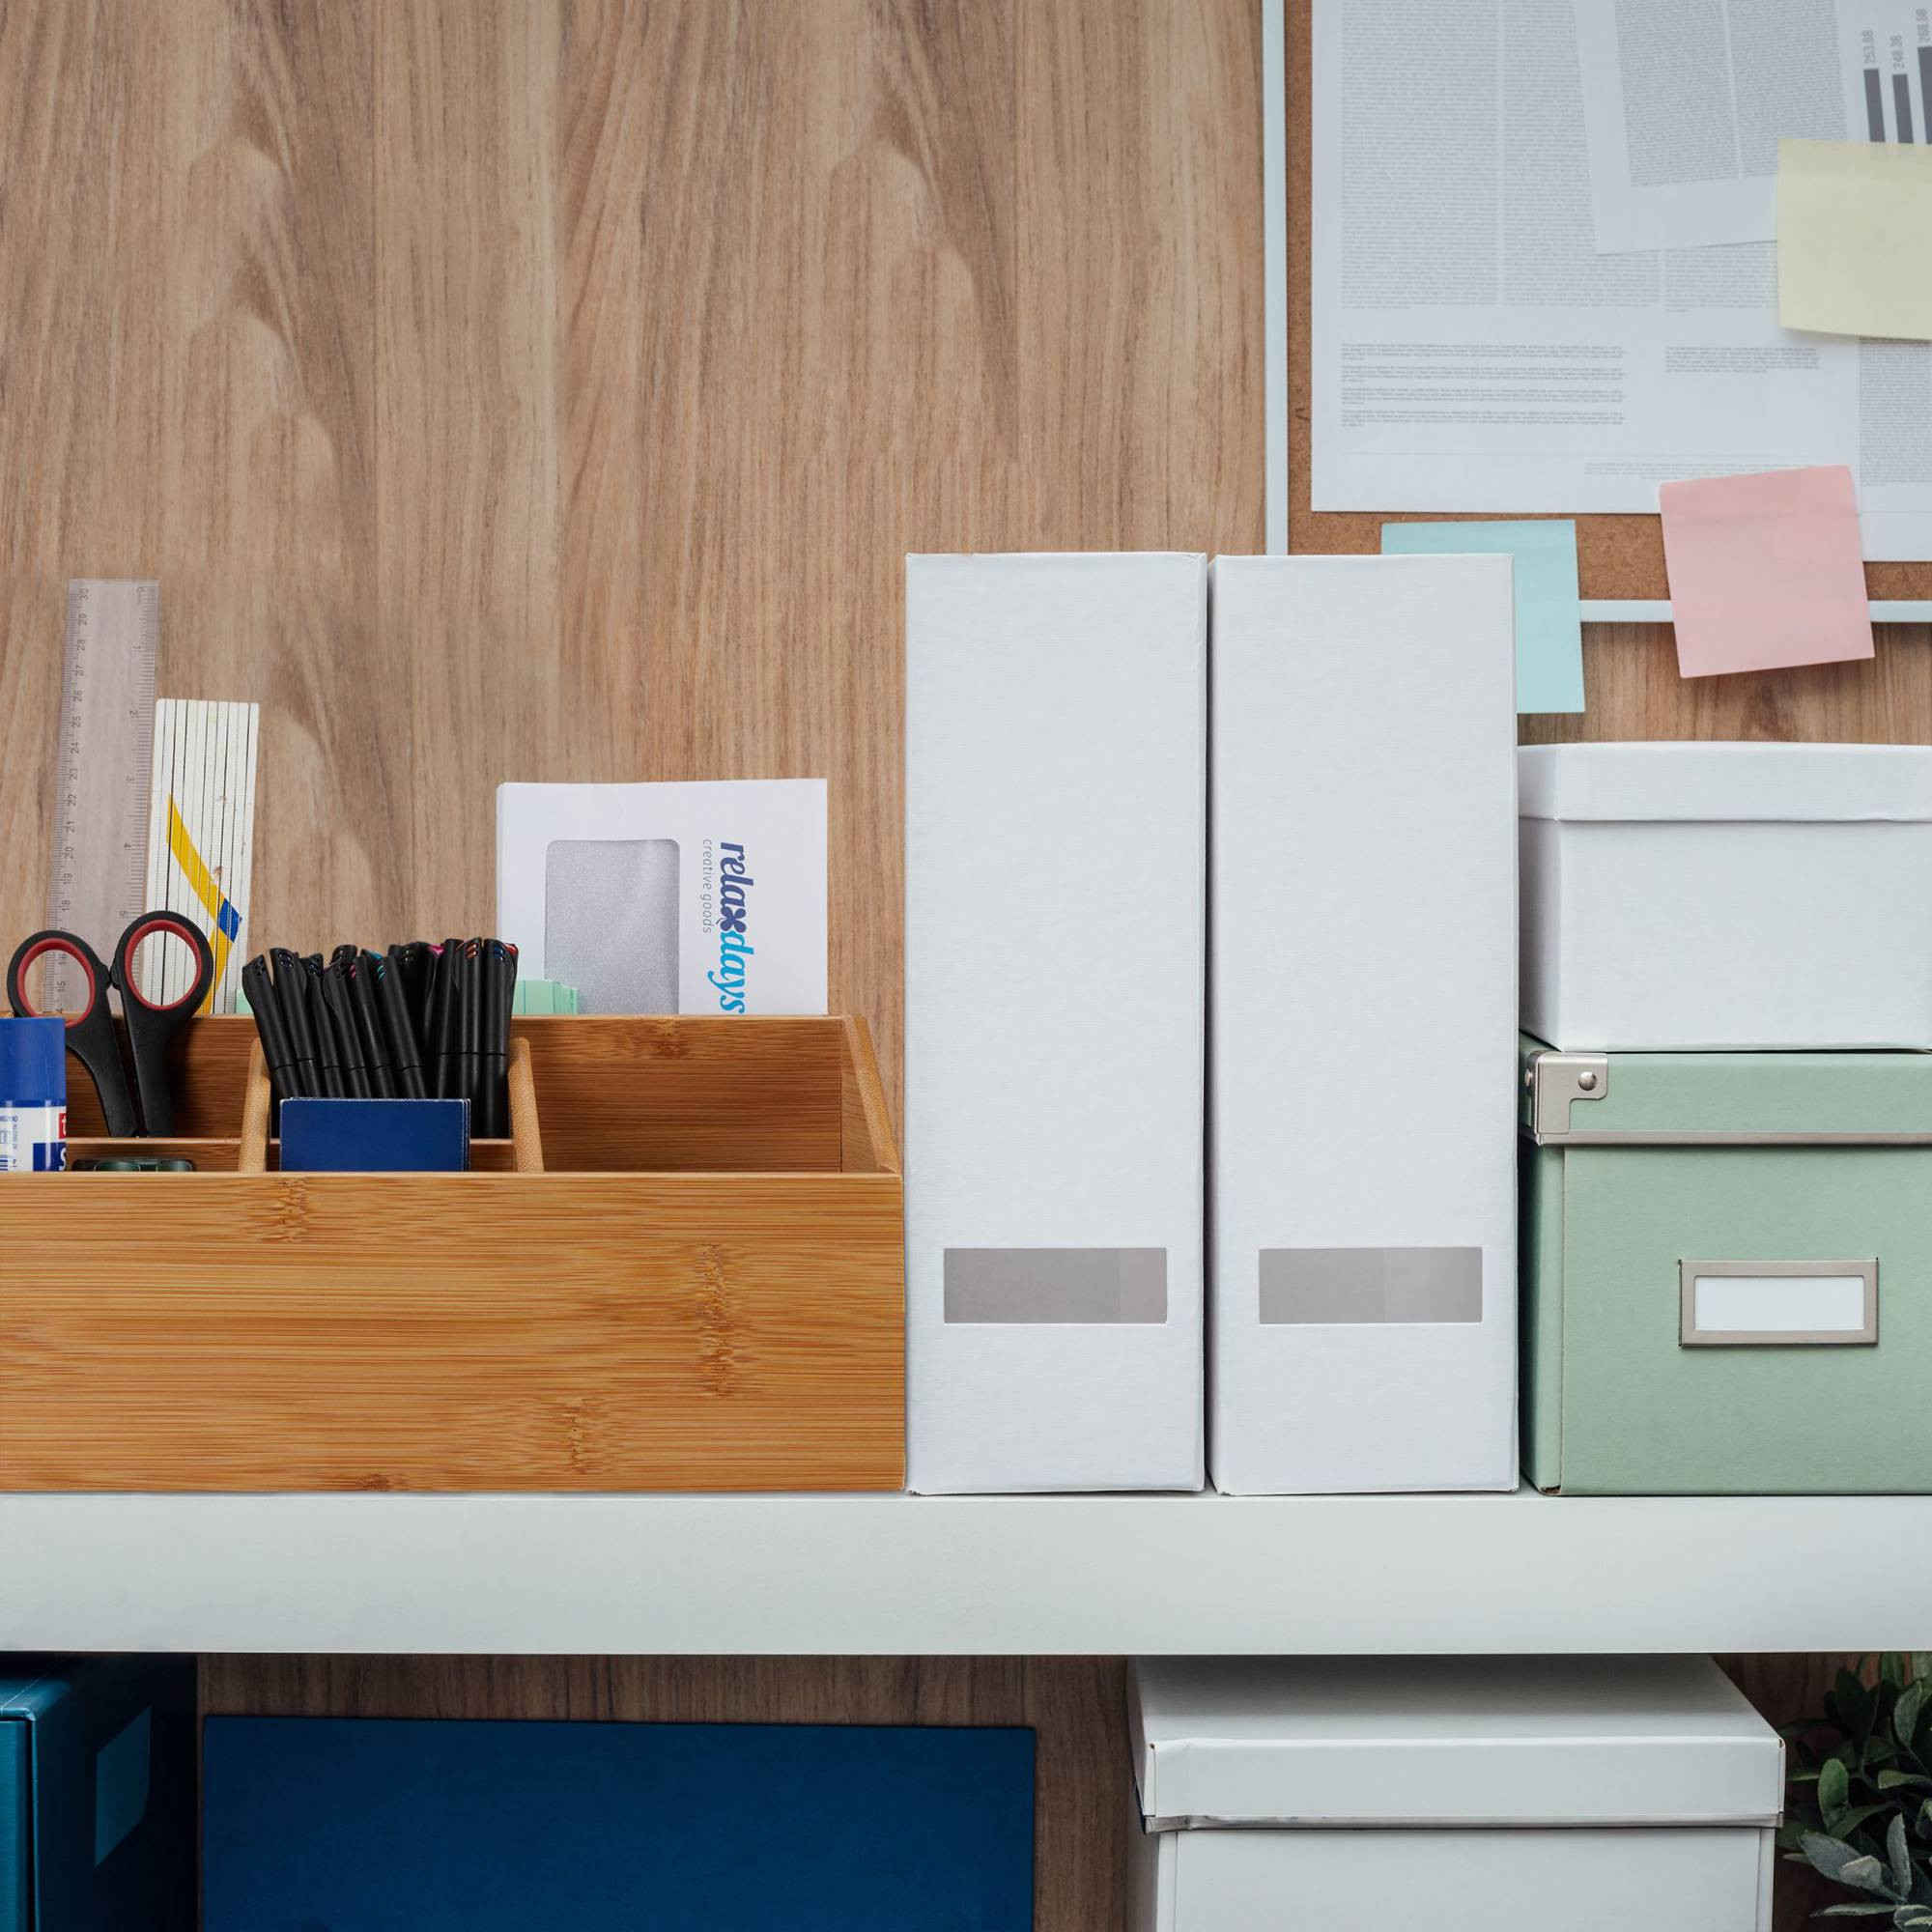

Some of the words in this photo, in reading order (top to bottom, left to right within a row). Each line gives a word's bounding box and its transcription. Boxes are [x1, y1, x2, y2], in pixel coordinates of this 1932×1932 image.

[79, 587, 89, 600] 30
[78, 613, 87, 626] 29
[77, 639, 86, 651] 28
[75, 665, 84, 676] 27
[73, 690, 82, 702] 26
[71, 716, 81, 727] 25
[71, 742, 79, 753] 24
[70, 767, 77, 781] 23
[67, 793, 77, 806] 22
[65, 821, 75, 833] 21
[64, 846, 74, 859] 20
[702, 838, 713, 891] creative
[63, 872, 72, 884] 19
[61, 899, 71, 912] 18
[699, 892, 713, 933] goods
[707, 841, 754, 1014] relaxdays
[58, 952, 68, 965] 16
[56, 980, 67, 992] 15
